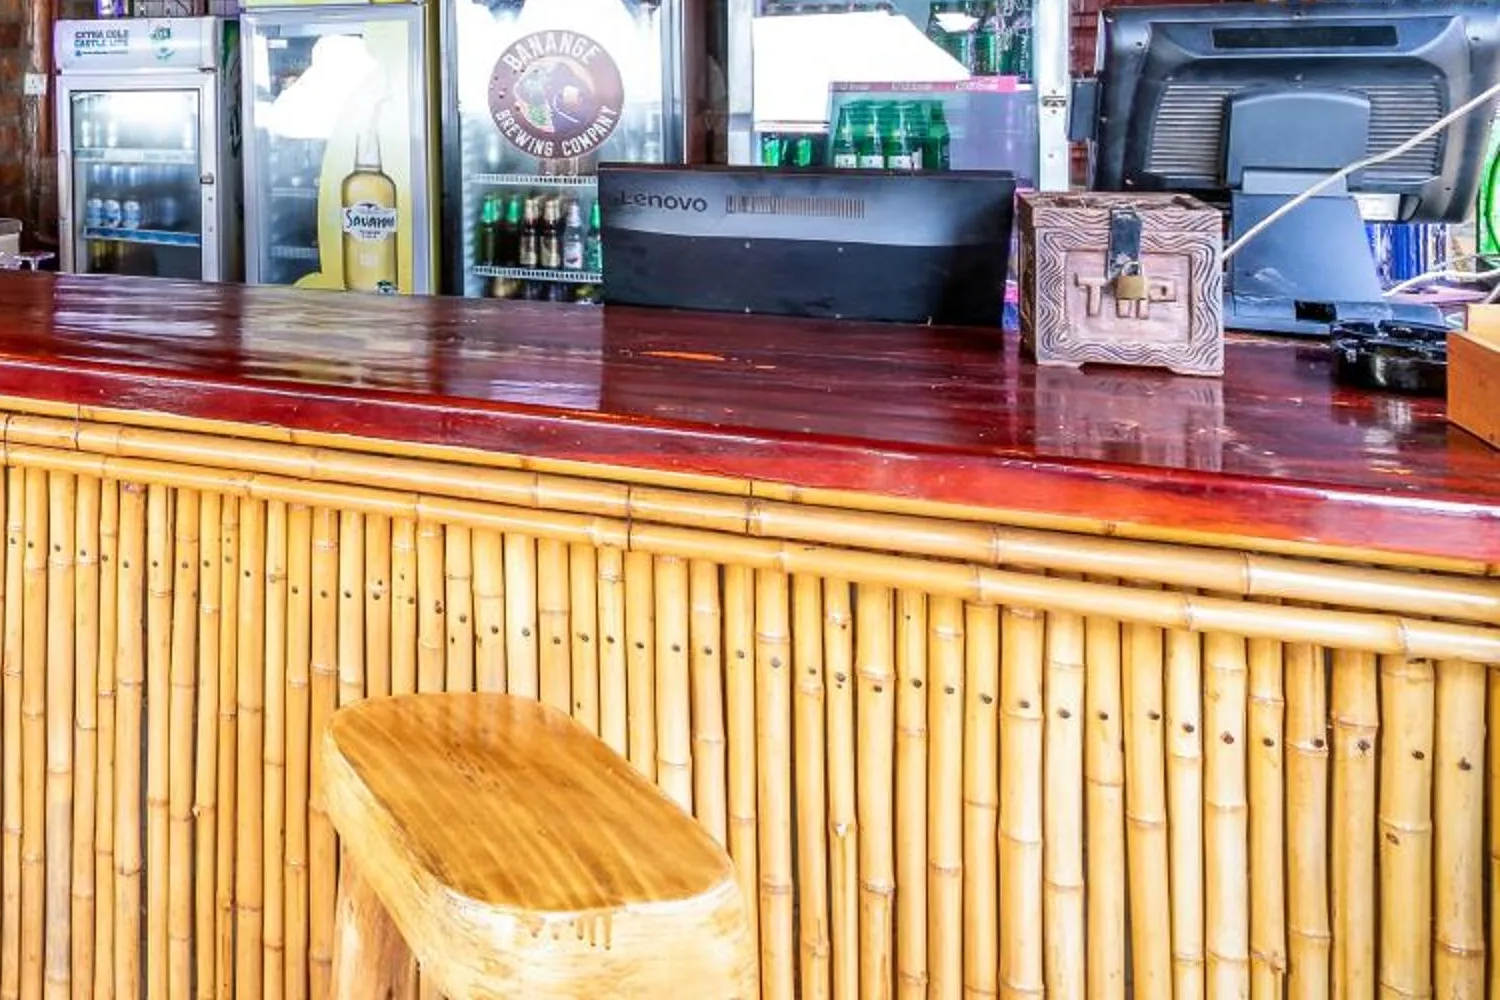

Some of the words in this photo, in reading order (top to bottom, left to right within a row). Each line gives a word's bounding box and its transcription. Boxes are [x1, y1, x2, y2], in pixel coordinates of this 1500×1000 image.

[503, 31, 601, 71] BANANGE
[495, 109, 554, 157] BREWING
[561, 104, 618, 156] COMPANY
[620, 190, 708, 213] Lenovo
